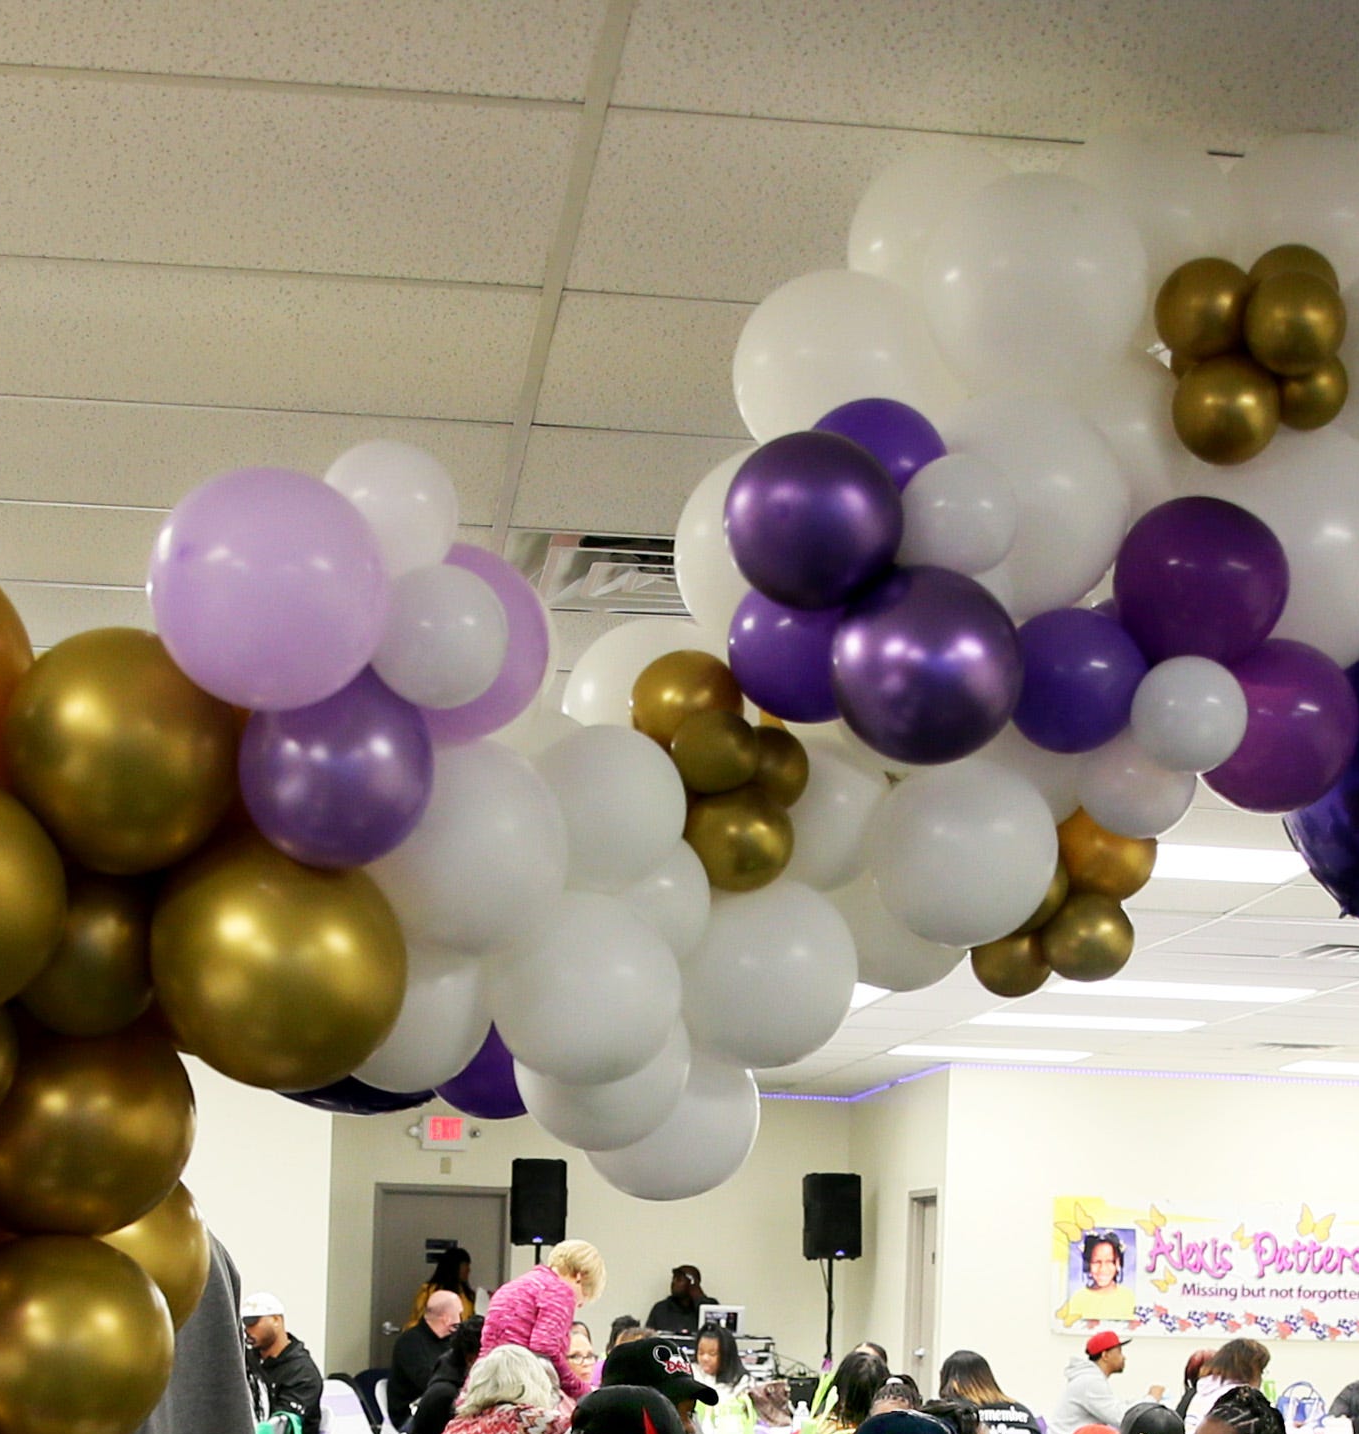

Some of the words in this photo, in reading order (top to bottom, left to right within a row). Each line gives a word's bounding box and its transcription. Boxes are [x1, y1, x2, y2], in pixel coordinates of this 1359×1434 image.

[430, 1116, 462, 1140] EXIT
[1145, 1227, 1232, 1279] Alexis
[1181, 1283, 1238, 1300] Missing
[1241, 1284, 1266, 1298] but
[1270, 1287, 1295, 1299] not
[979, 1406, 1029, 1423] emember
